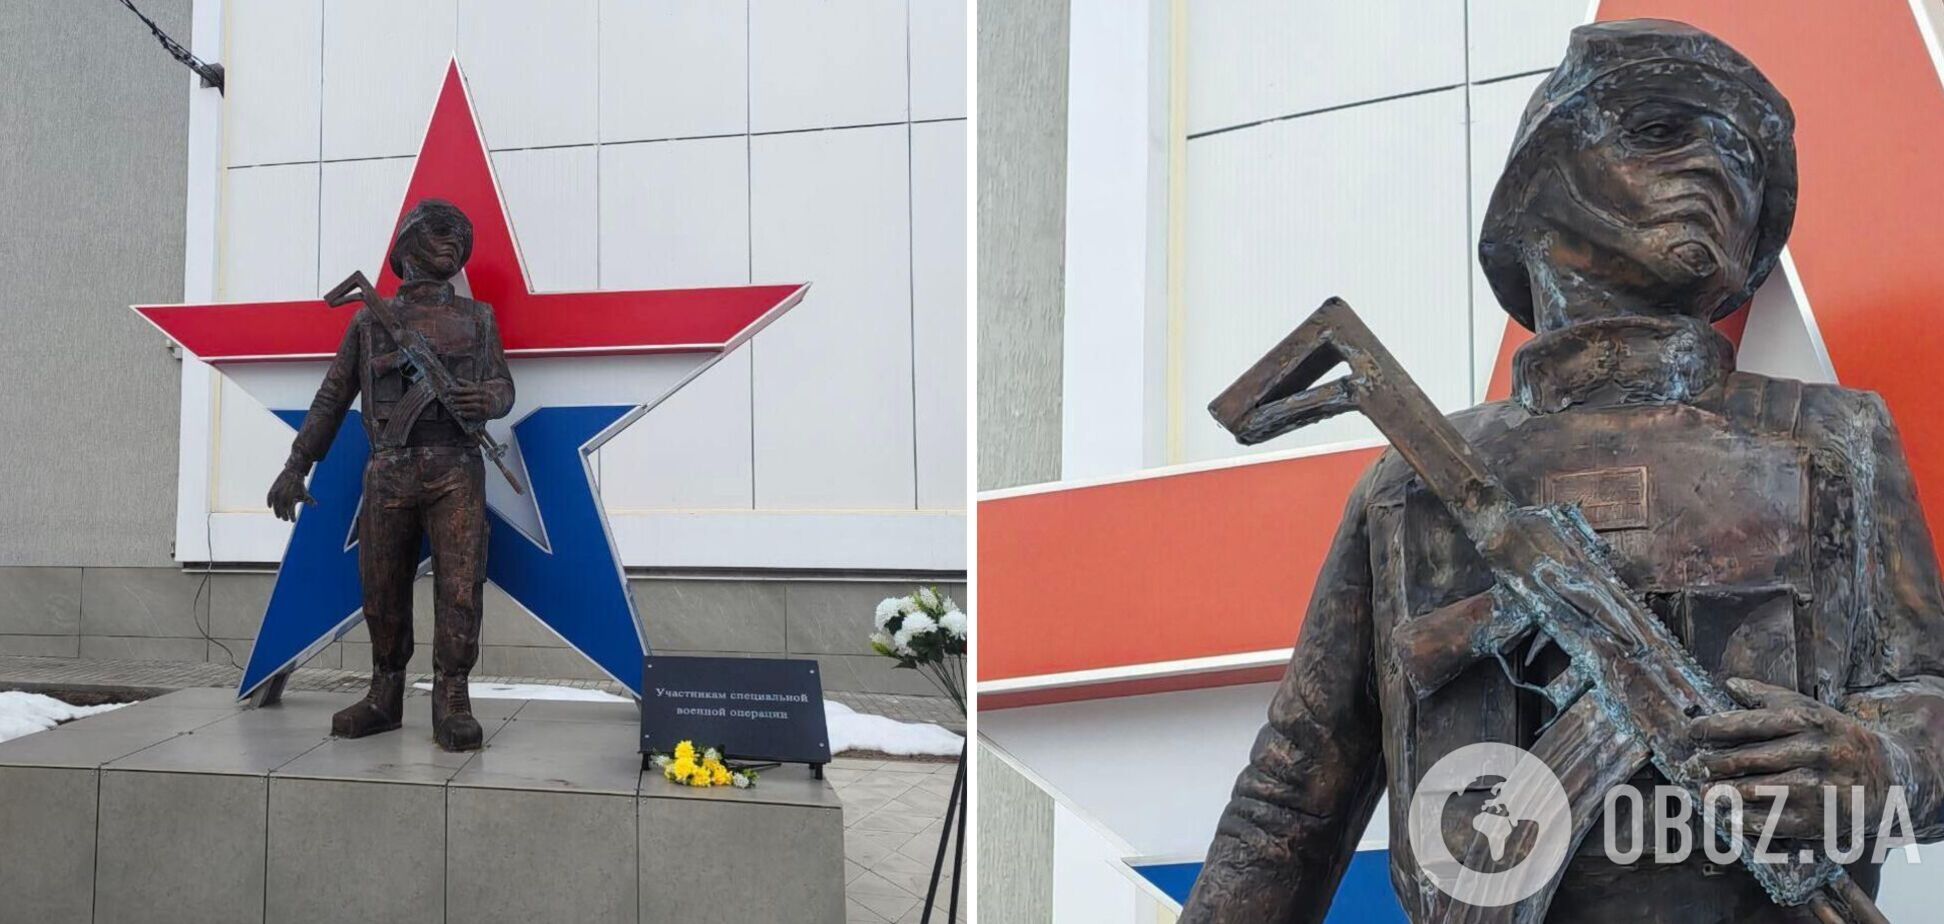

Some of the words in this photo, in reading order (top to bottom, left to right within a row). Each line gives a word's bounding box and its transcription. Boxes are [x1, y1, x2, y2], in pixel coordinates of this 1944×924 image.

[656, 688, 726, 700] Участникам
[730, 691, 809, 703] специальной
[676, 706, 726, 717] военной
[730, 710, 788, 720] операции
